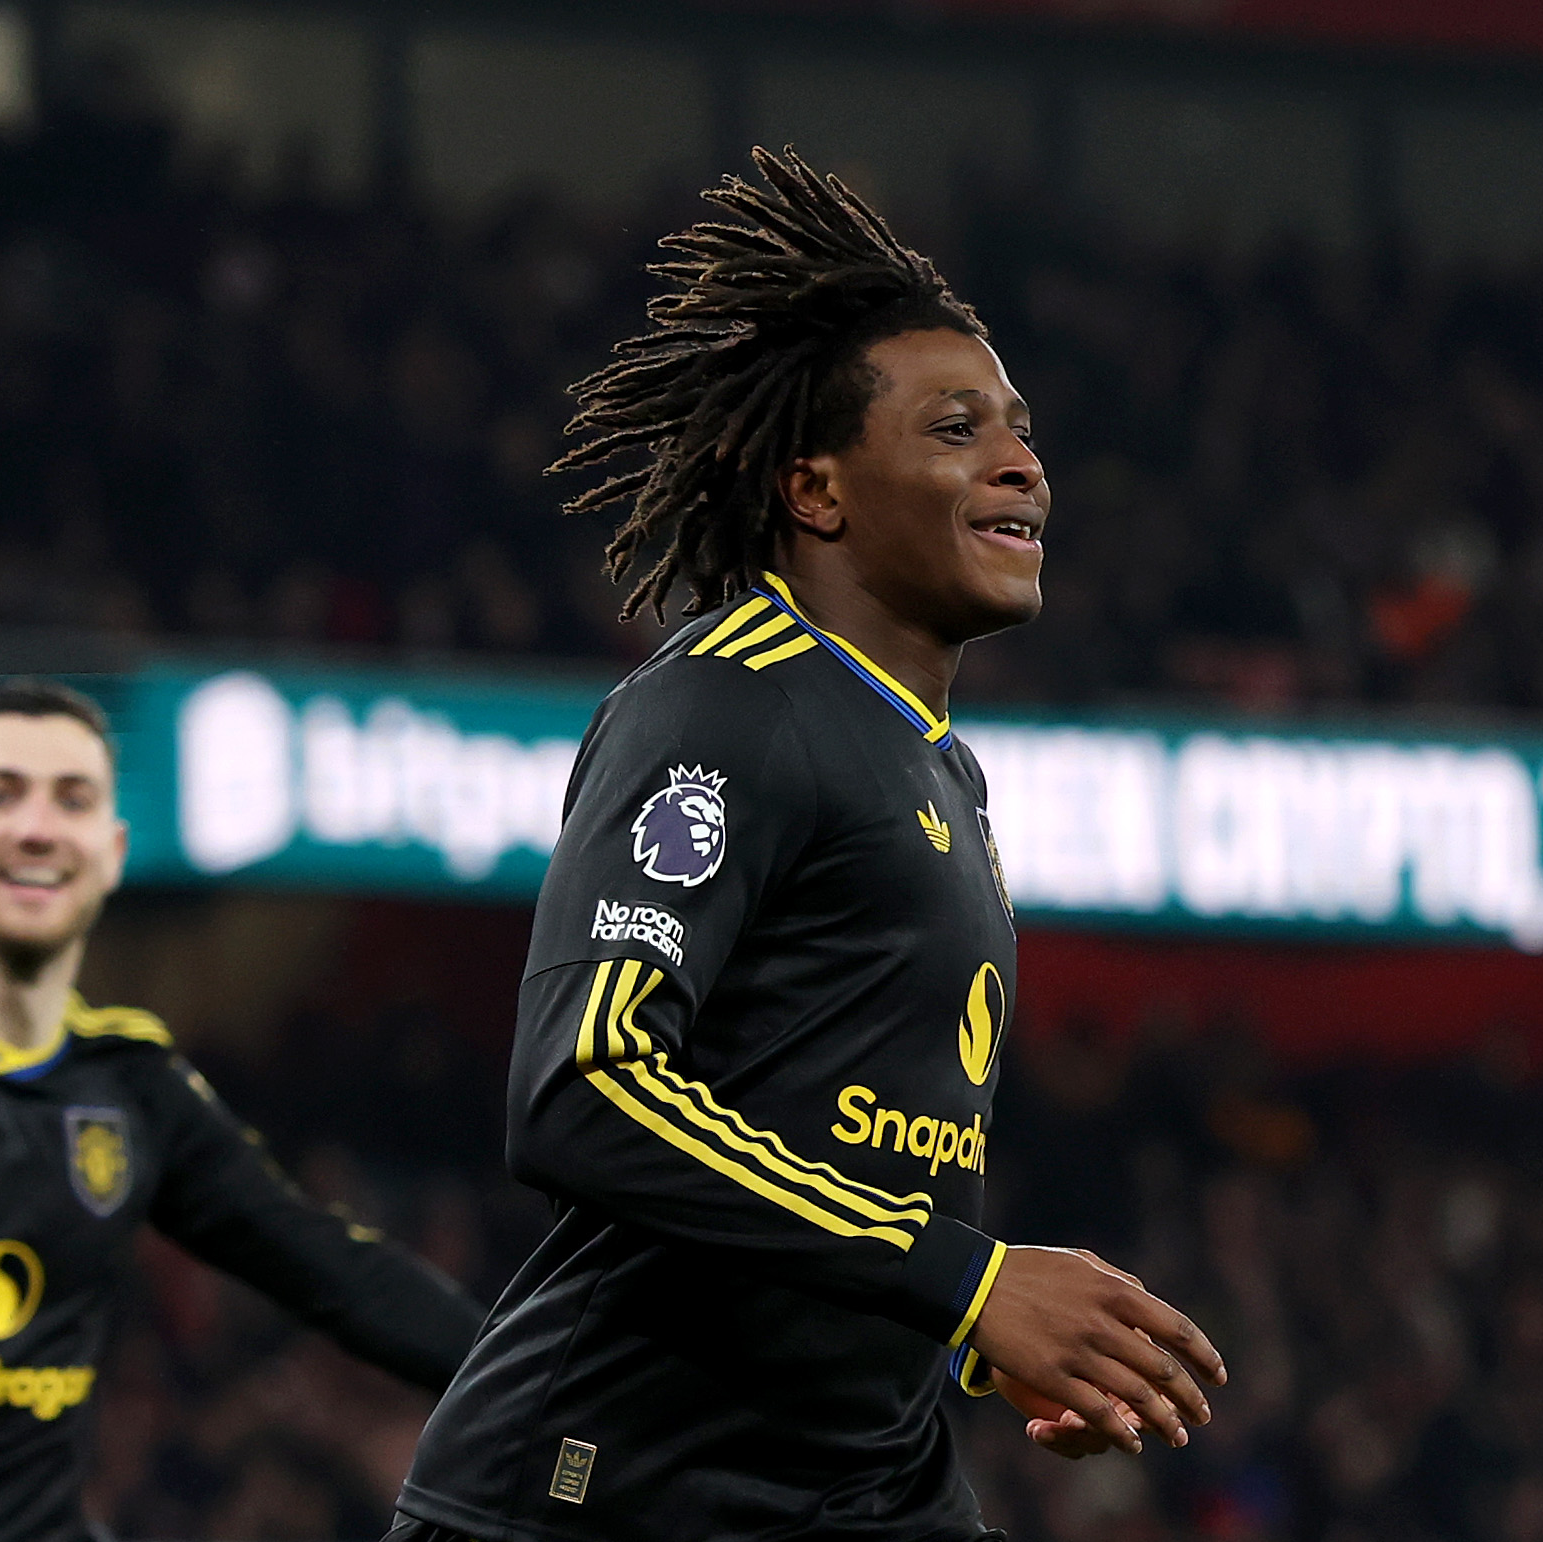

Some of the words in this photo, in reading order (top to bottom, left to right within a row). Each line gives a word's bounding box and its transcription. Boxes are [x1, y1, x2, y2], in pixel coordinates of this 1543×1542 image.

[595, 899, 630, 923] No
[631, 906, 684, 943] room
[623, 923, 683, 967] racism
[830, 1084, 986, 1177] Snapdr
